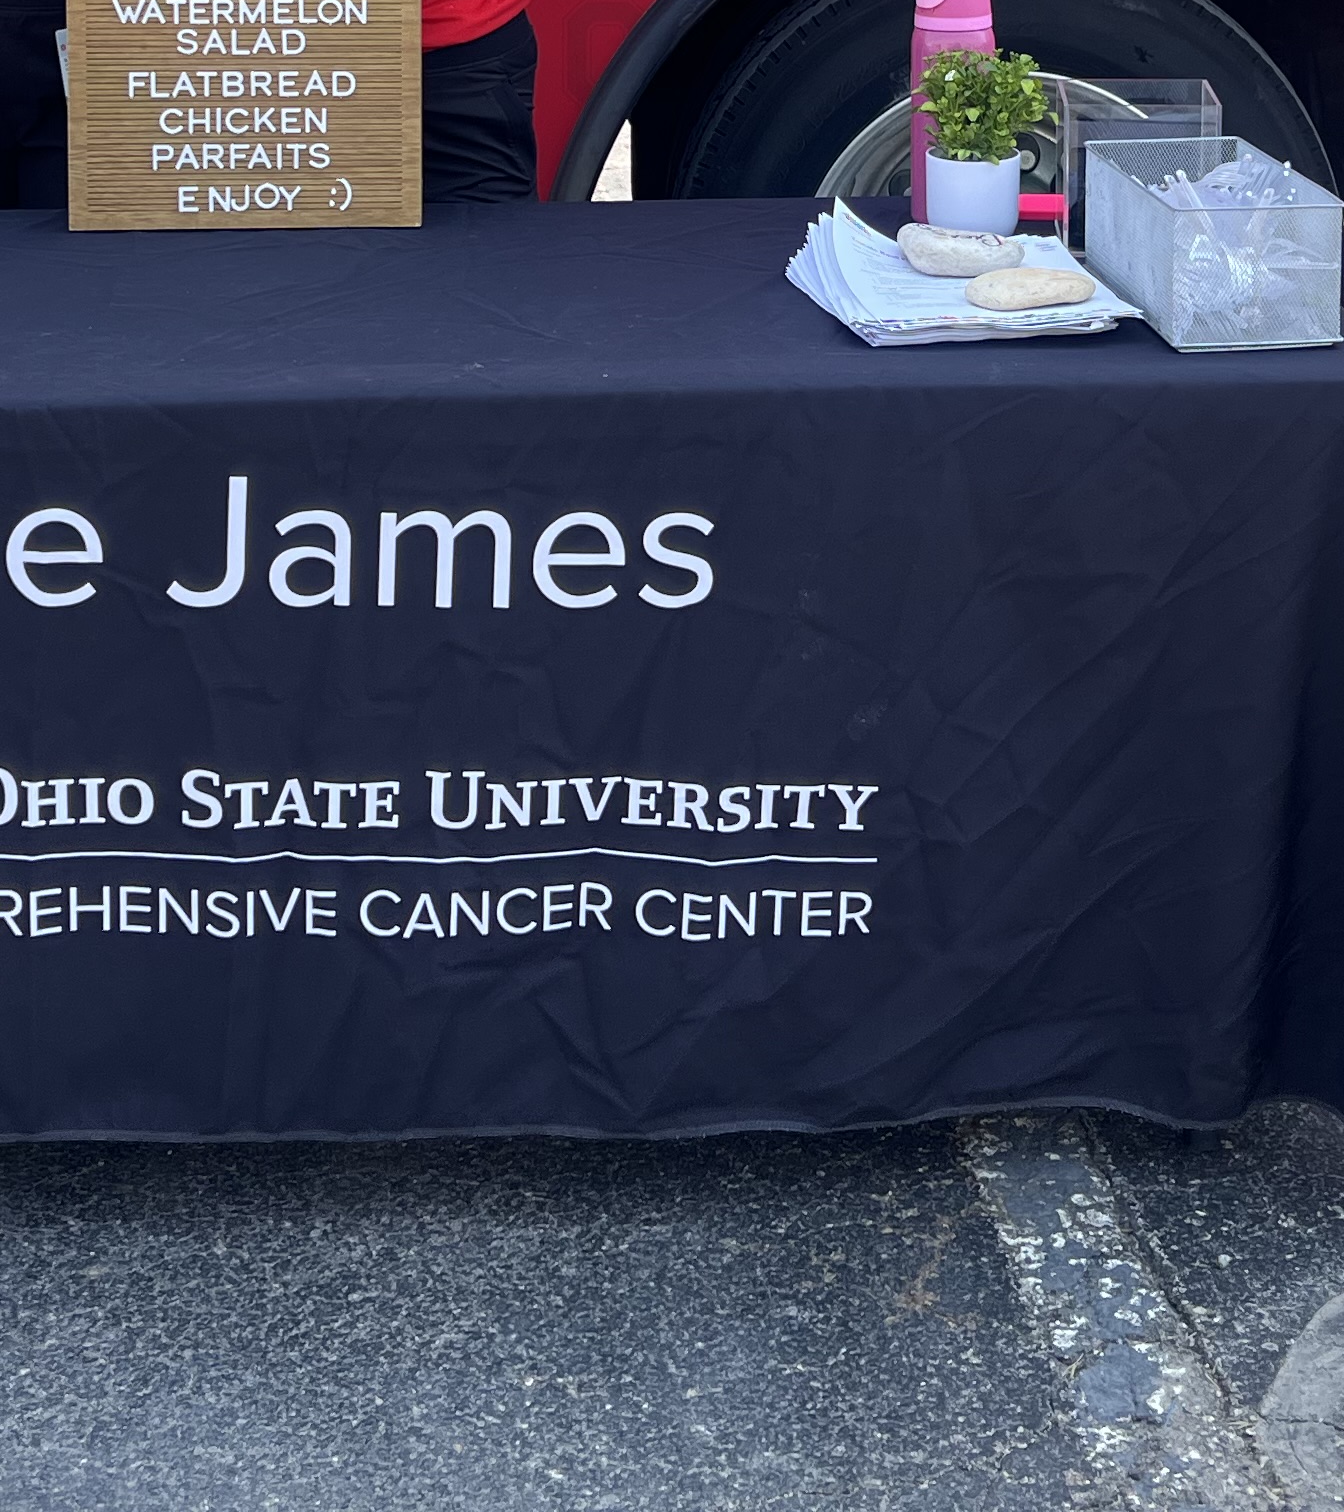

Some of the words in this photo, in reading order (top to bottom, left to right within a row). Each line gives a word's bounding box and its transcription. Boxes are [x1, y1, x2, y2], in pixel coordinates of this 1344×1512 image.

[176, 27, 307, 56] SALAD
[128, 70, 357, 99] FLATBREAD
[159, 106, 328, 135] CHICKEN
[152, 143, 331, 171] PARFAITS
[178, 182, 302, 213] ENJOY
[166, 475, 715, 609] James
[181, 768, 400, 830] STATE
[425, 770, 879, 833] UNIVERSITY
[359, 881, 613, 939] CANCER
[635, 889, 873, 941] CENTER
